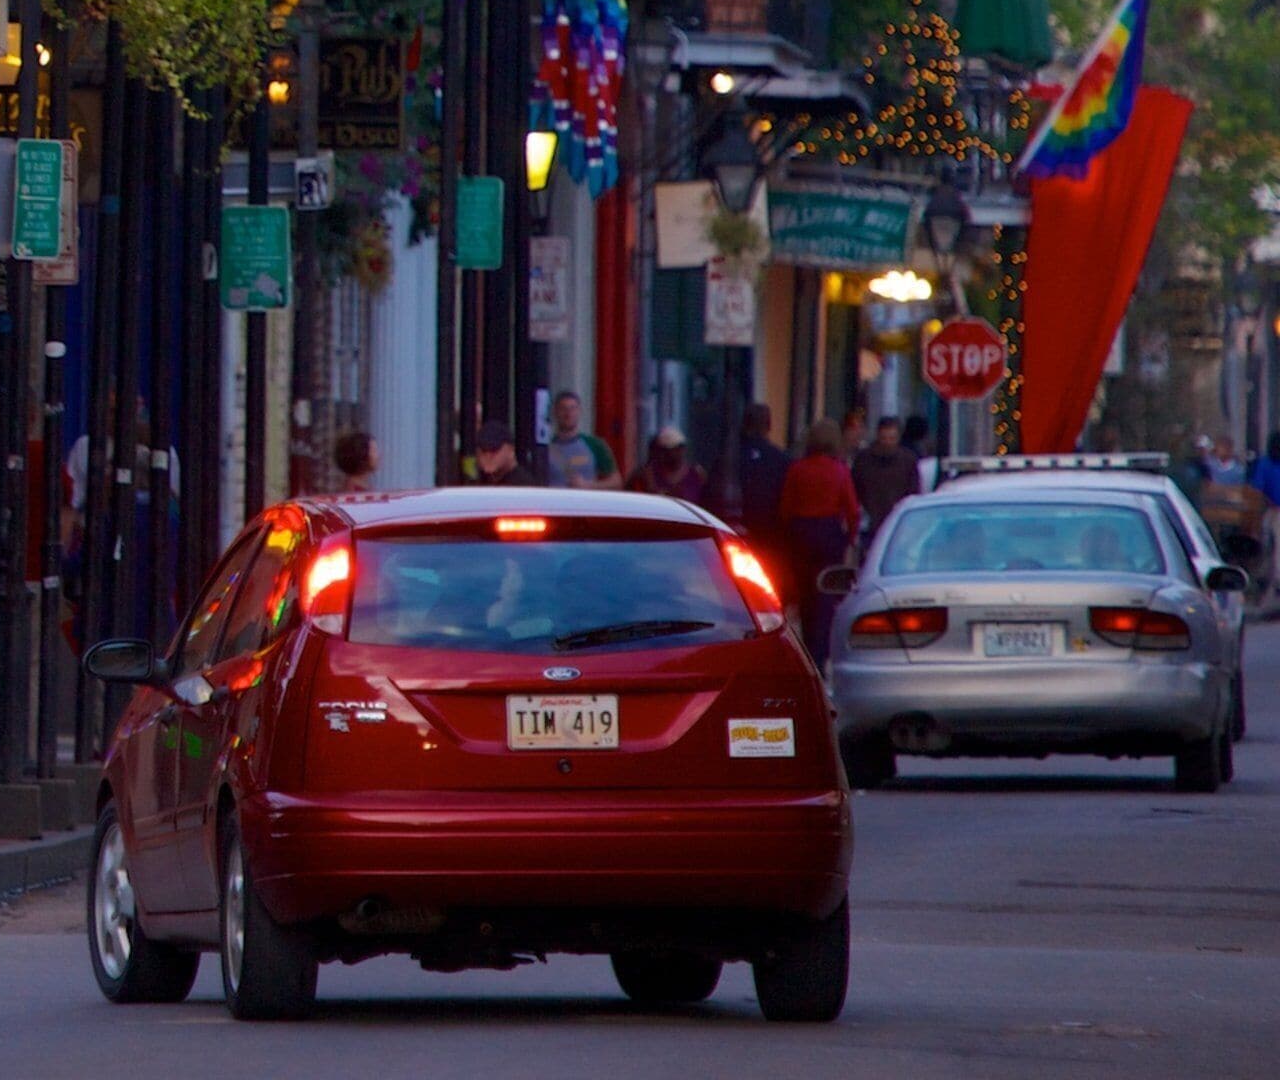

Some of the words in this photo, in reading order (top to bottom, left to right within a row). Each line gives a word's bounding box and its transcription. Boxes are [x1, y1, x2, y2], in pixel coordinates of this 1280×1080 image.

[929, 343, 1001, 376] STOP
[515, 710, 557, 735] TIM
[572, 710, 613, 735] 419
